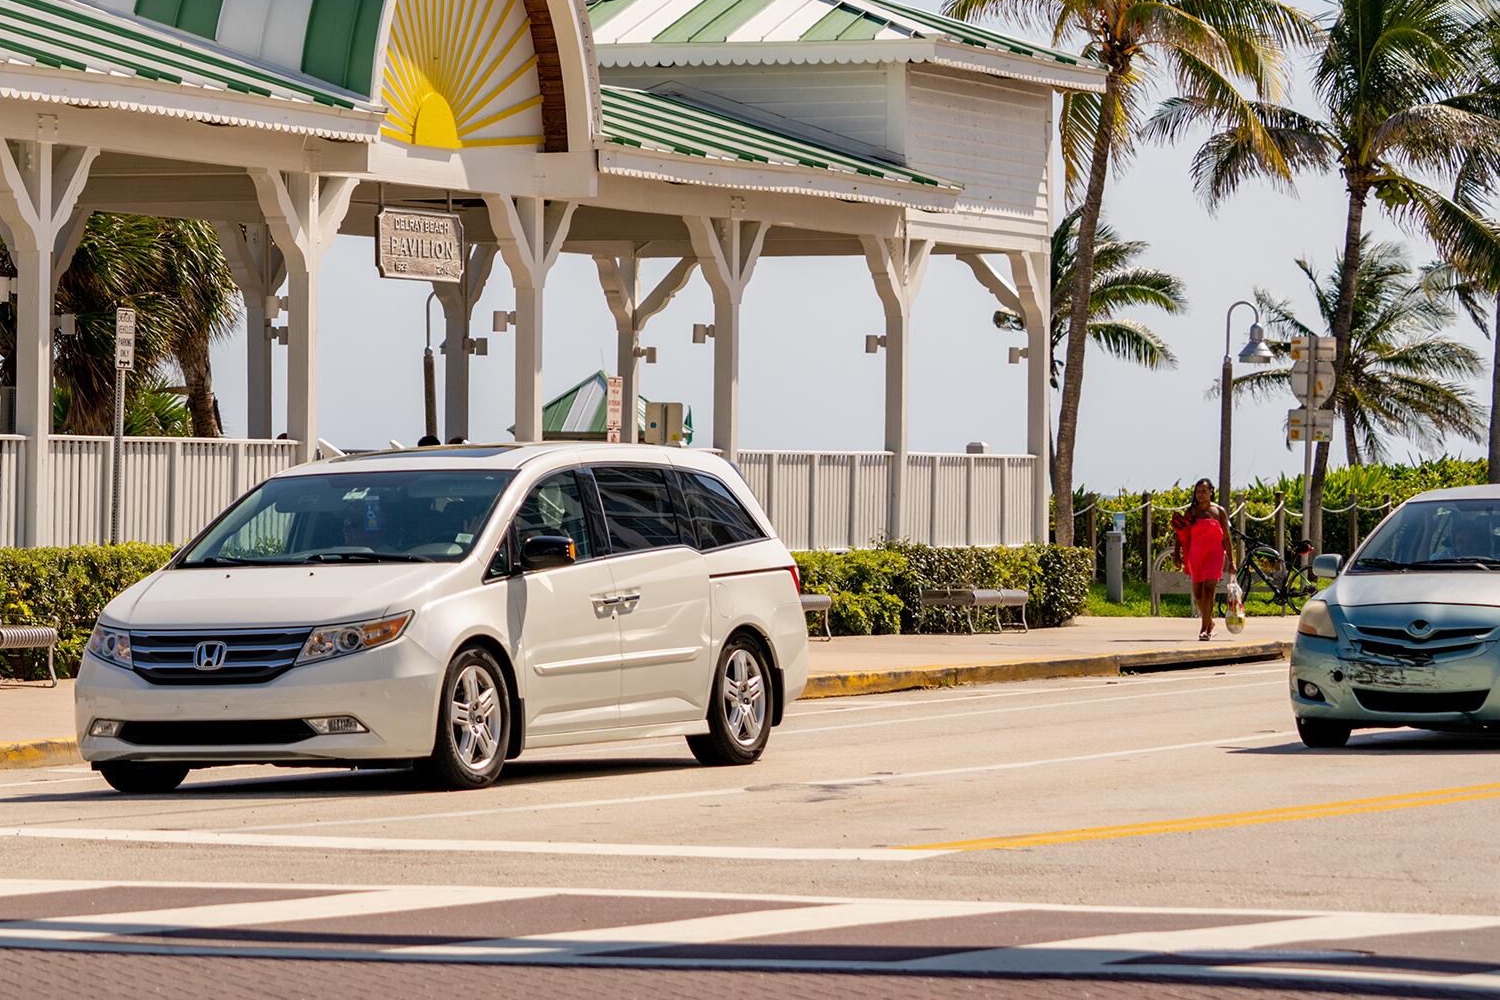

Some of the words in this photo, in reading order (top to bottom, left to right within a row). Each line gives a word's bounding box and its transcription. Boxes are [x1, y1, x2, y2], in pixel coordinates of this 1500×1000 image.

[394, 218, 422, 232] DELRAY
[424, 220, 449, 234] BEACH
[390, 236, 453, 260] PAVILION
